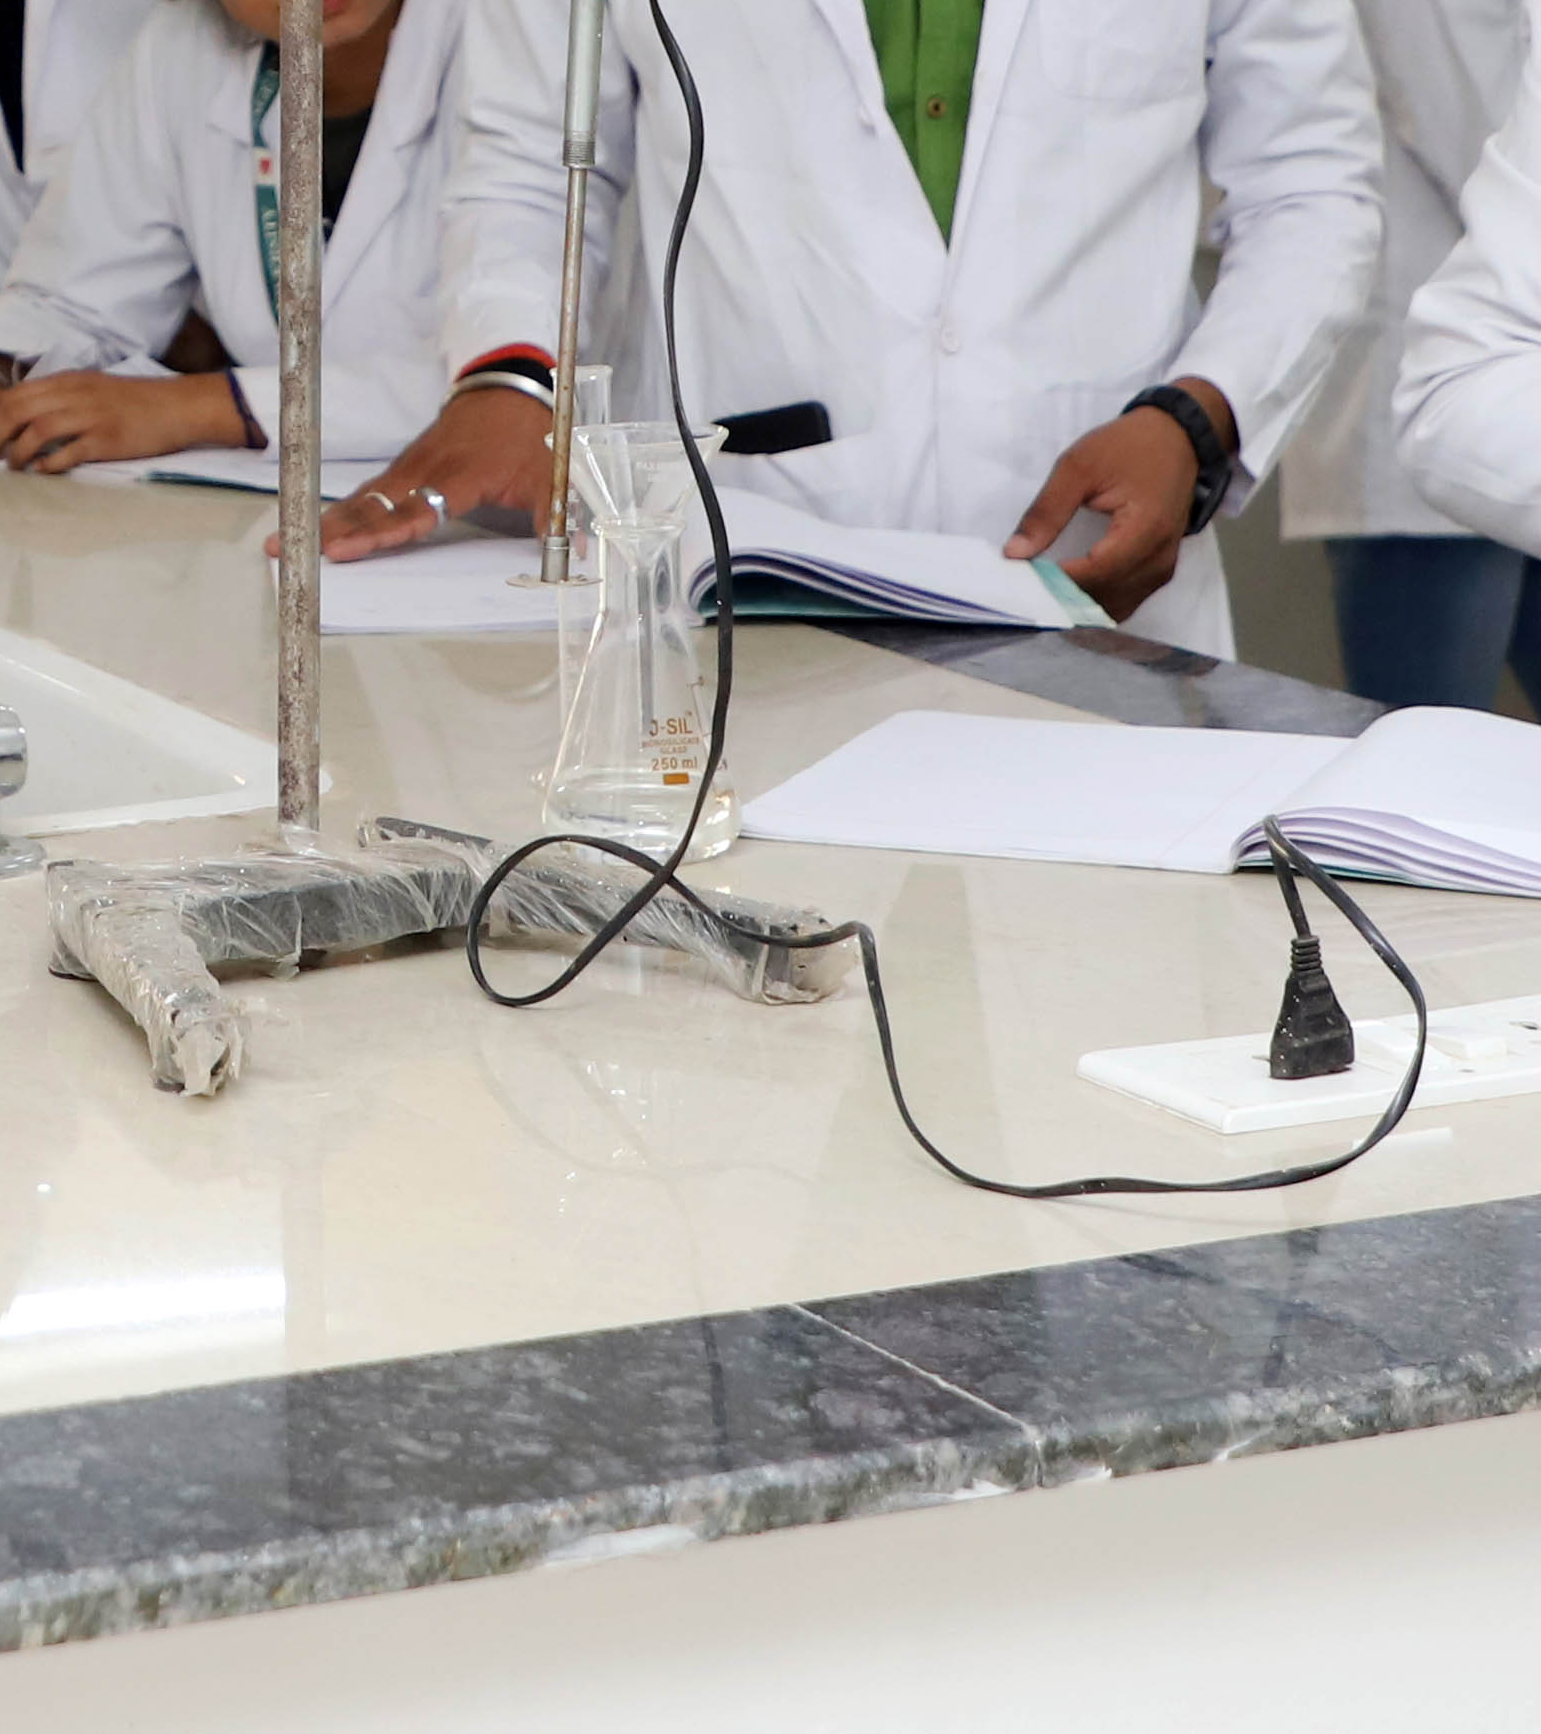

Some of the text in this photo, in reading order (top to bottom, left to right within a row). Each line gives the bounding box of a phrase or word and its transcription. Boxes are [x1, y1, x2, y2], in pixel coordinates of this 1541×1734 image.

[649, 718, 693, 737] J-SIL
[652, 757, 678, 771] 250
[682, 756, 698, 770] ml
